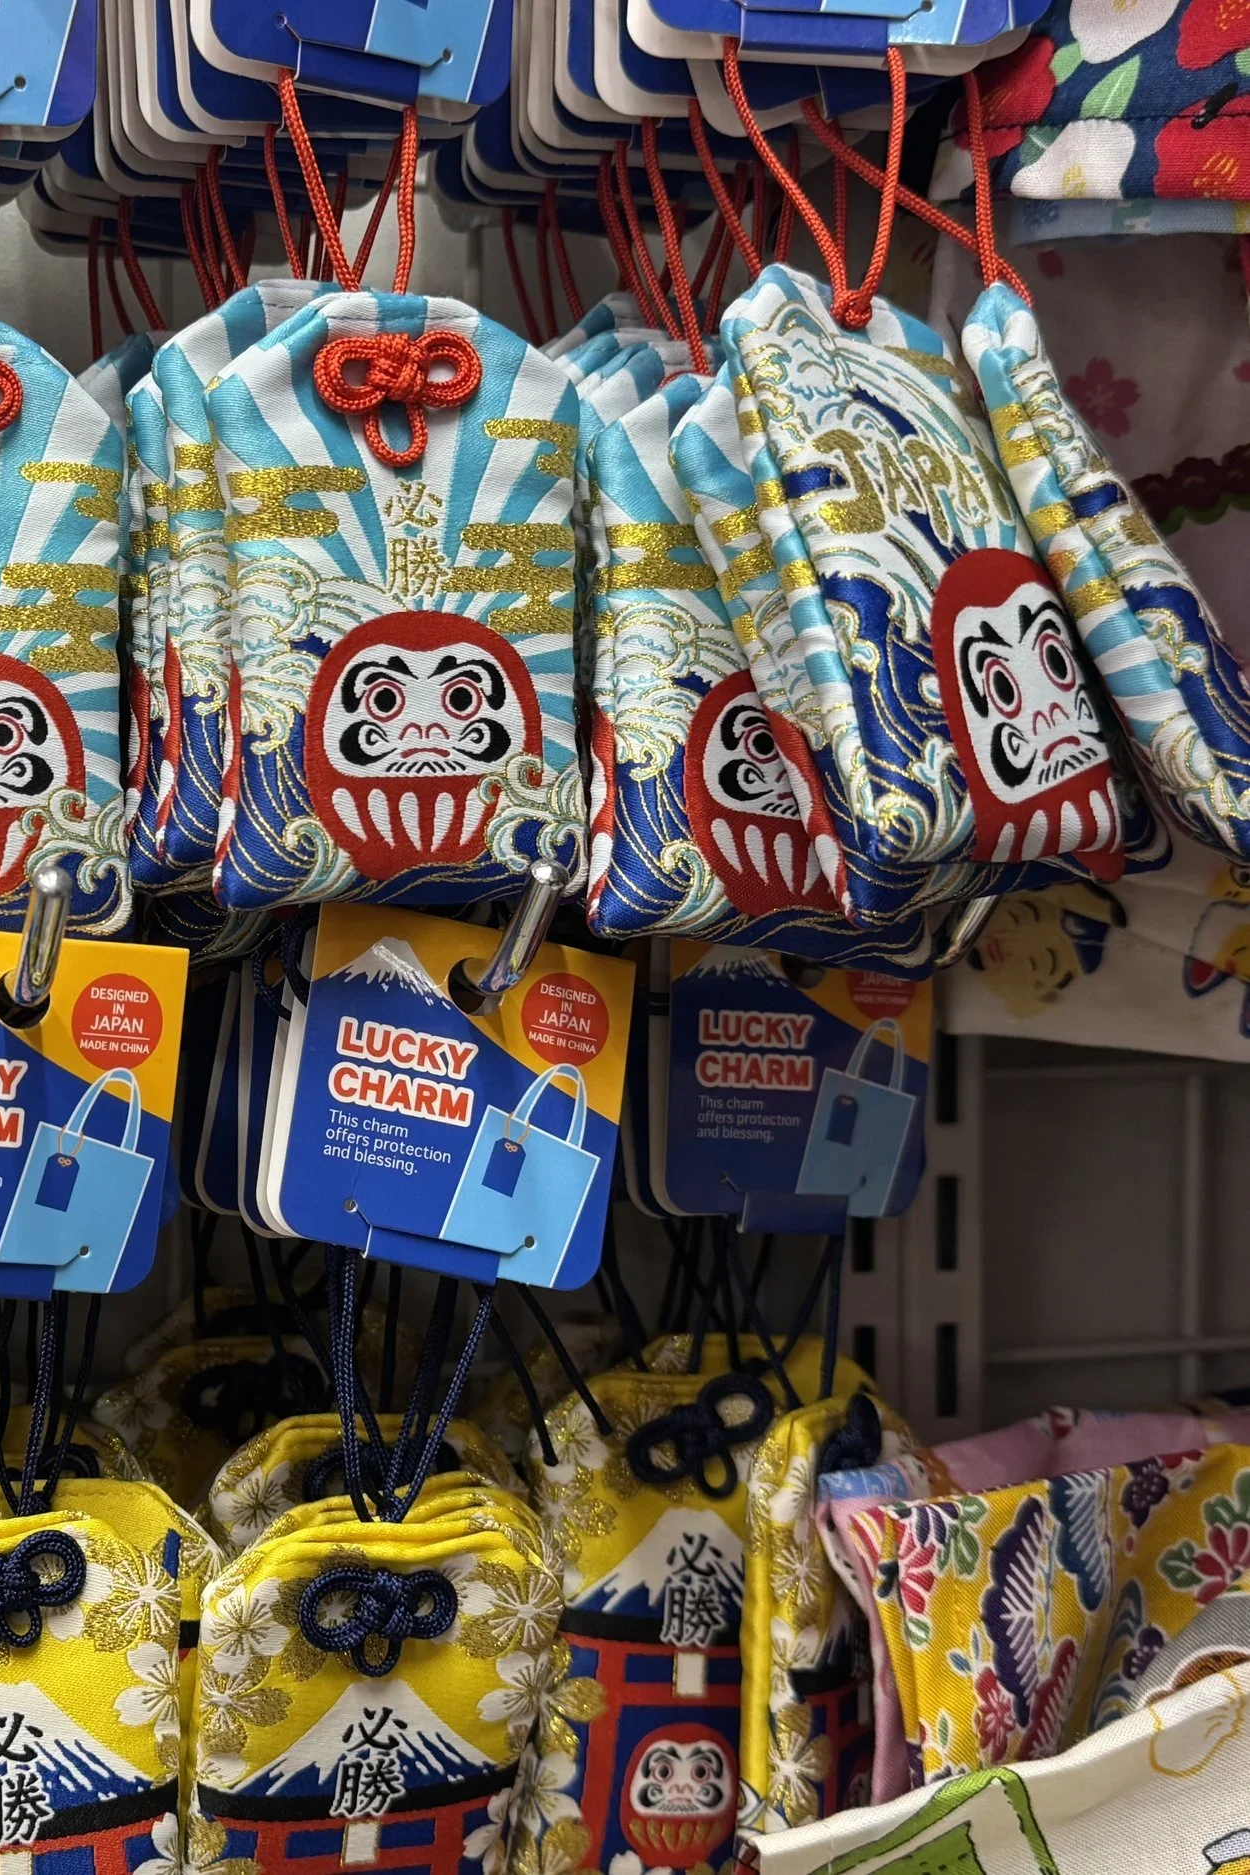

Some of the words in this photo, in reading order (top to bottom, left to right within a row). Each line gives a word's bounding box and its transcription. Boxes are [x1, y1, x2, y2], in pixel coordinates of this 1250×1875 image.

[90, 987, 149, 1004] DESIGNED
[540, 983, 596, 1005] DESIGNED
[112, 1002, 125, 1015] IN
[560, 1000, 573, 1013] IN
[90, 1014, 144, 1034] JAPAN
[538, 1009, 591, 1034] JAPAN
[700, 1012, 812, 1046] LUCKY
[79, 1038, 107, 1050] MADE
[109, 1042, 119, 1052] IN
[120, 1042, 150, 1054] CHINA
[339, 1019, 476, 1077] LUCKY
[529, 1030, 555, 1044] MADE
[556, 1037, 567, 1048] IN
[568, 1039, 597, 1054] CHINA
[697, 1052, 812, 1089] CHARM
[331, 1064, 472, 1124] CHARM
[699, 1095, 723, 1109] This
[726, 1096, 764, 1110] charm
[329, 1109, 358, 1128] This
[362, 1118, 408, 1138] charm
[697, 1112, 734, 1124] offers
[736, 1114, 800, 1127] protection
[325, 1127, 370, 1146] offers
[373, 1138, 451, 1164] protection
[697, 1127, 719, 1138] and
[722, 1127, 774, 1143] blessing.
[323, 1143, 350, 1159] and
[354, 1149, 418, 1175] blessing.
[662, 1533, 726, 1645] 必勝
[331, 1707, 409, 1816] 必勝
